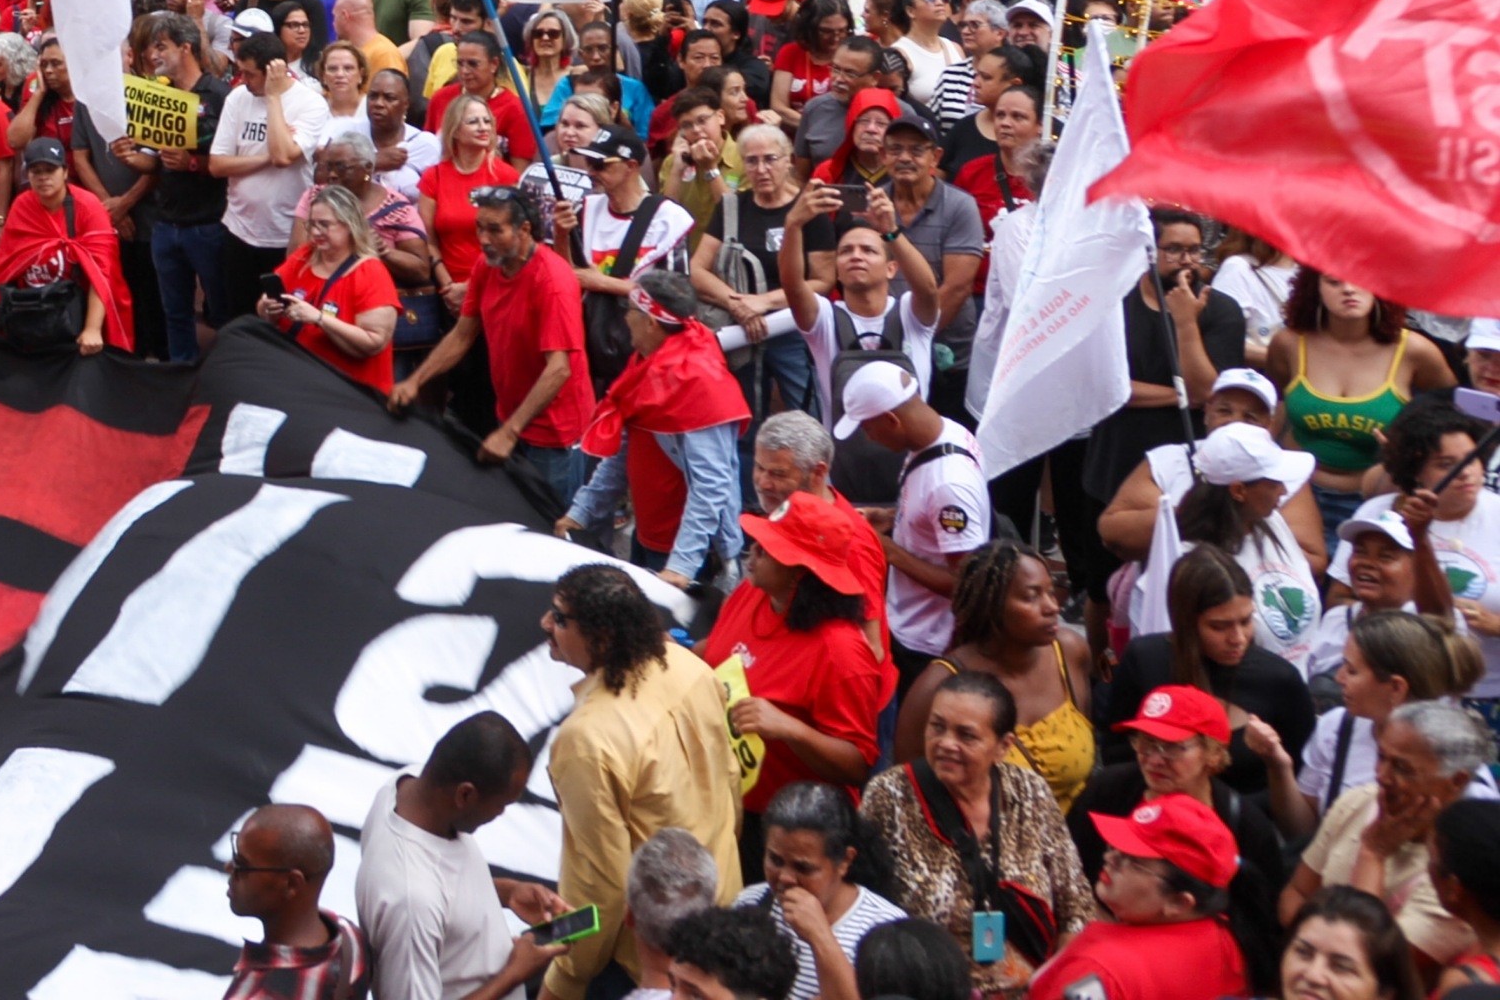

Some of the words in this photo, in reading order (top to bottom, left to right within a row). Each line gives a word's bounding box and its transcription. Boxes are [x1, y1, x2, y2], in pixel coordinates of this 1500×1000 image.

[124, 85, 189, 115] CONGRESSO
[126, 102, 187, 134] NIMIGO
[141, 127, 188, 148] POVO
[1303, 412, 1386, 433] BRASIL
